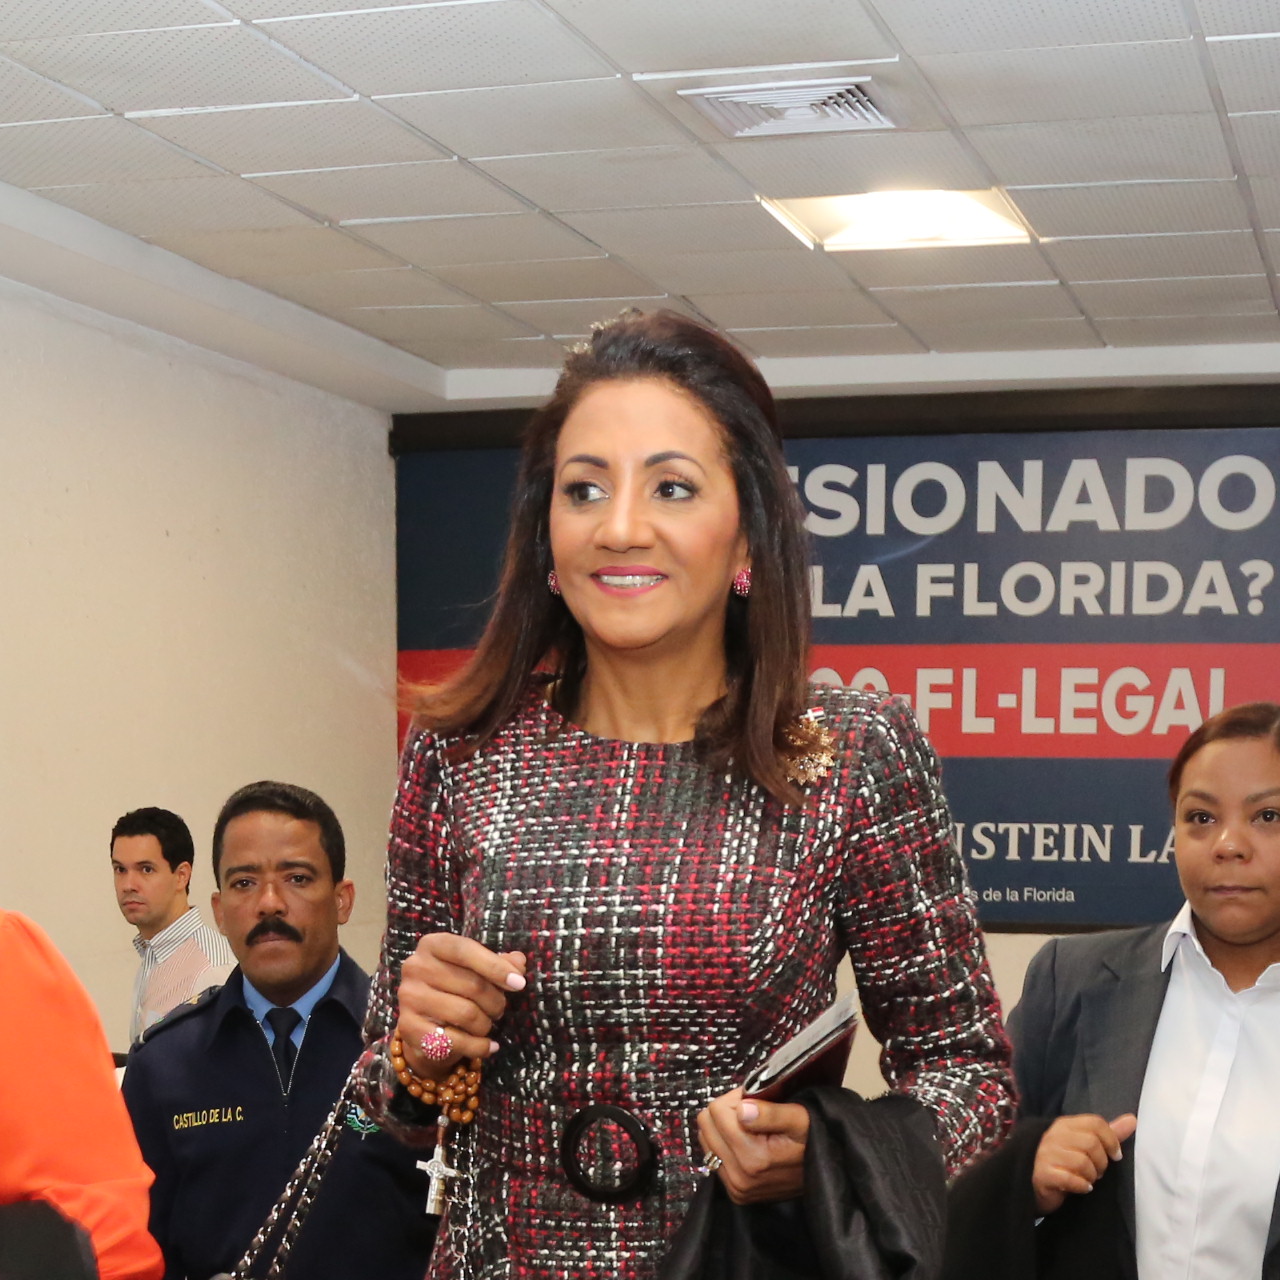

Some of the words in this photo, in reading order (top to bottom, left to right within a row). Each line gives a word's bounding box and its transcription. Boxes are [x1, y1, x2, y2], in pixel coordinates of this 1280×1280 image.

[787, 455, 1276, 538] SIONADO
[811, 563, 895, 618] LA
[915, 558, 1275, 618] FLORIDA?
[982, 887, 1002, 902] de
[1006, 887, 1020, 902] la
[1023, 887, 1075, 902] Florida
[173, 1110, 208, 1130] CASTILLO
[209, 1108, 220, 1123] DE
[222, 1107, 233, 1122] LA
[235, 1105, 244, 1121] C.
